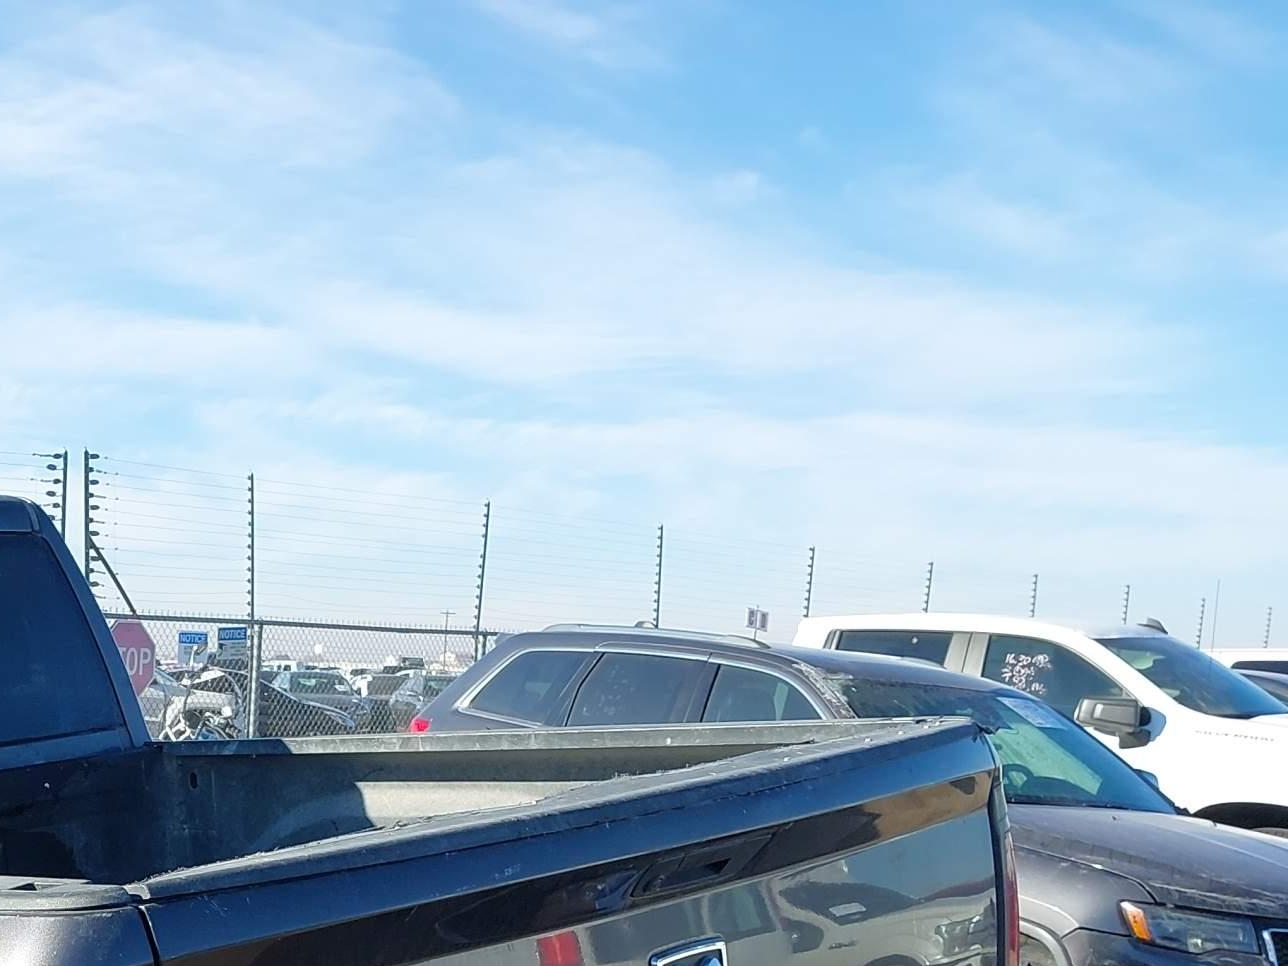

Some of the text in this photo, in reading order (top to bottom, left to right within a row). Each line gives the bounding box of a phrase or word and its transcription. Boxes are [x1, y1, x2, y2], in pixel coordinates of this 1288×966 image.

[180, 633, 207, 643] NOTICE
[219, 629, 246, 639] NOTICE
[118, 647, 151, 676] TOP
